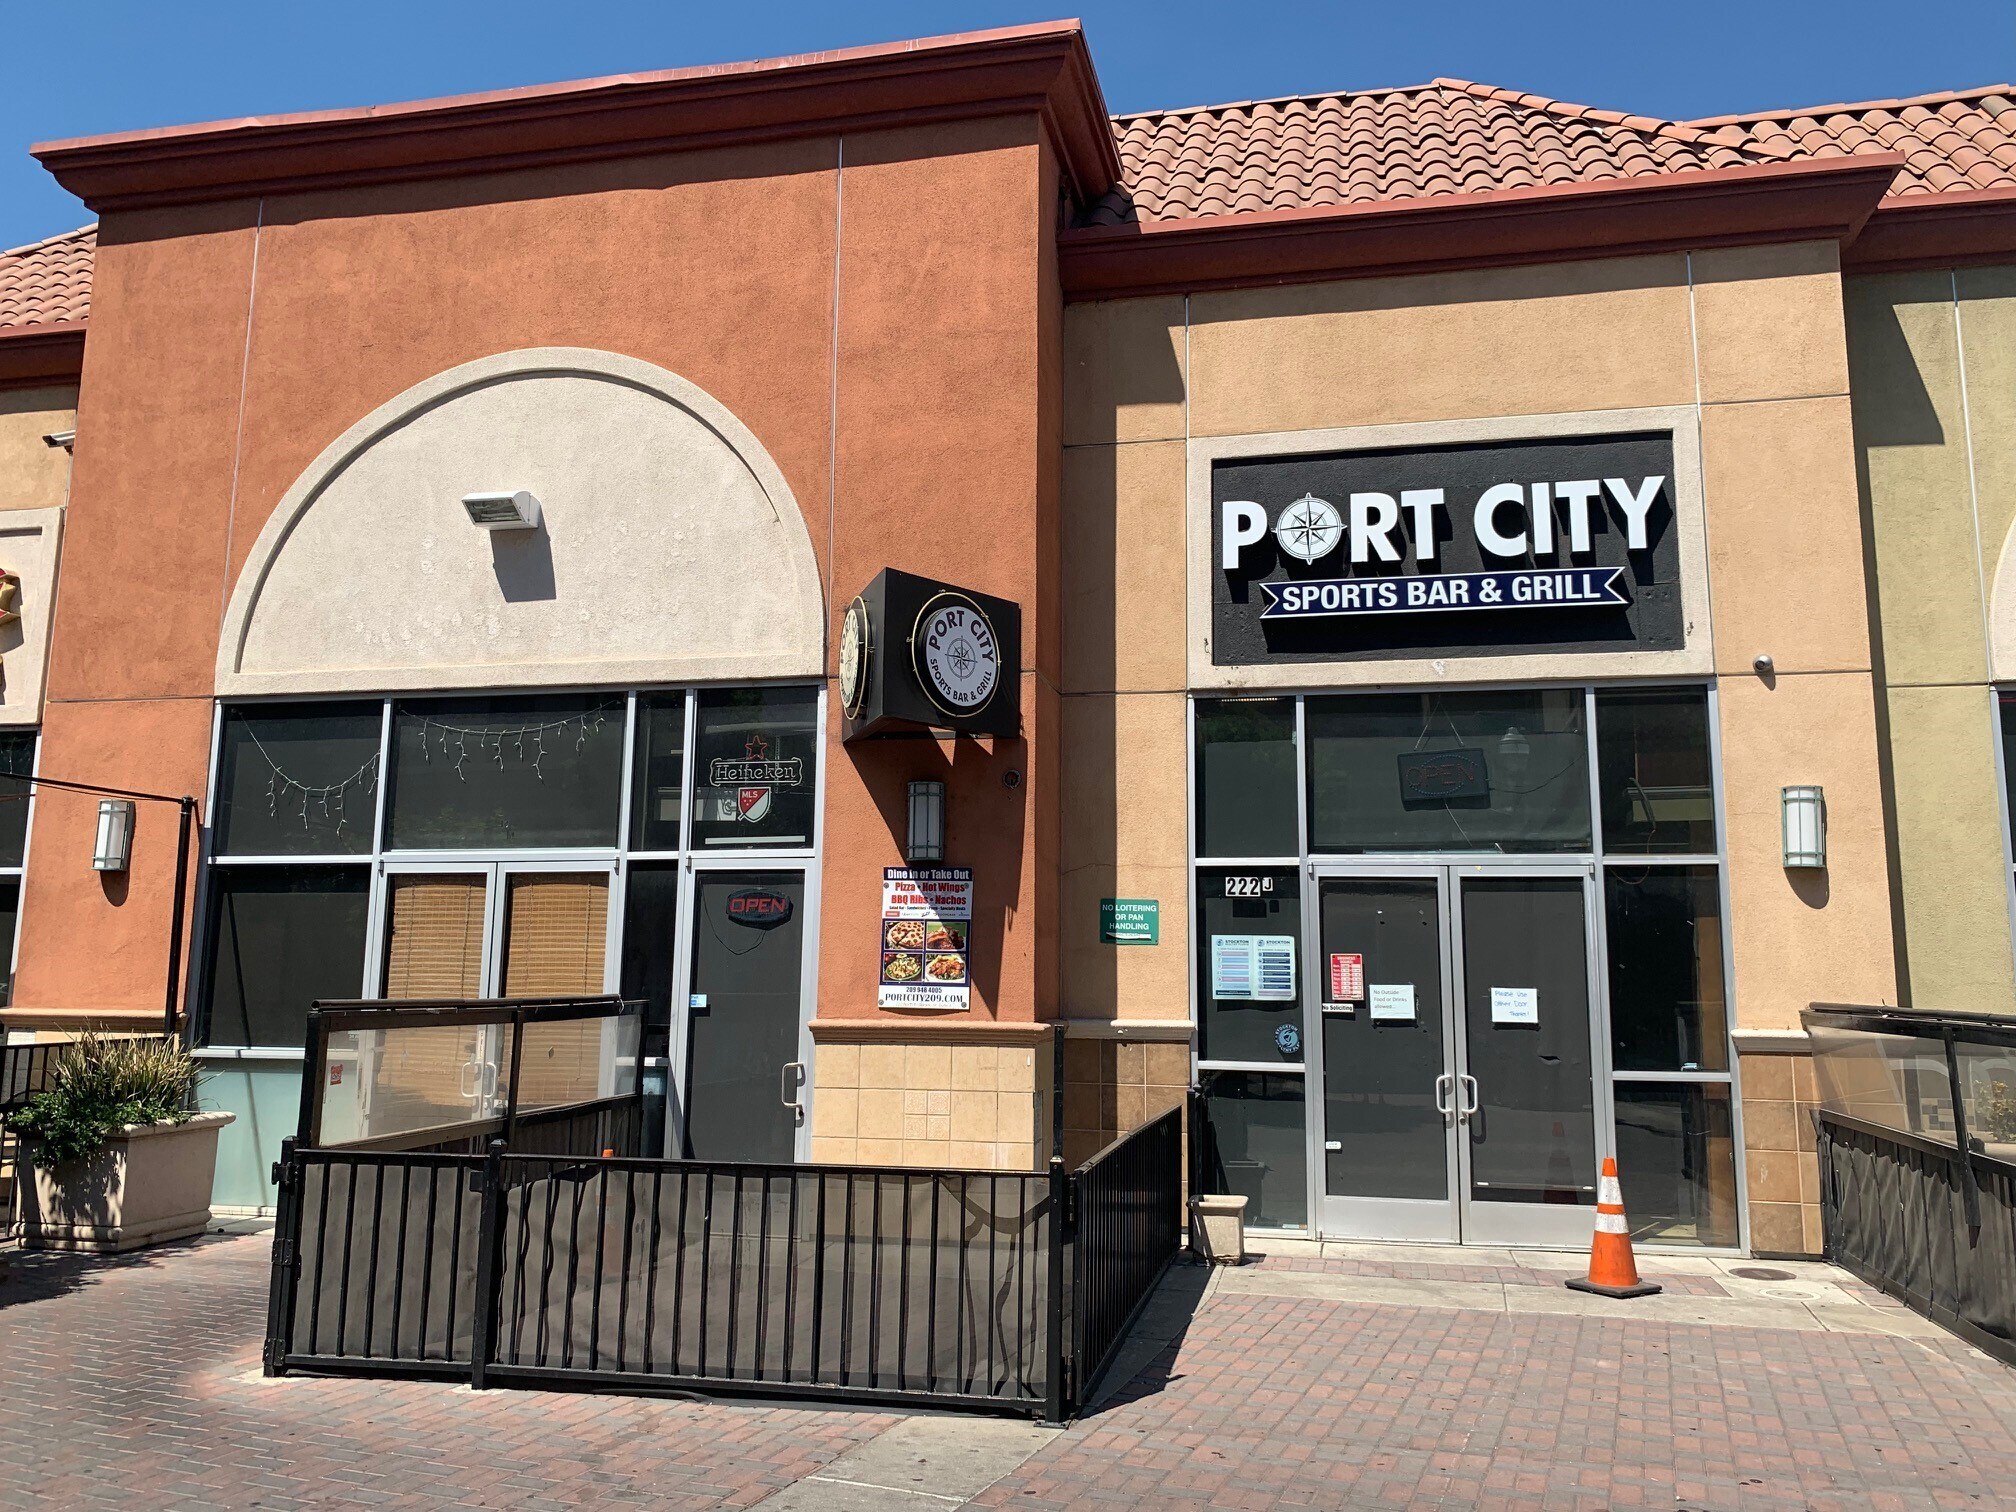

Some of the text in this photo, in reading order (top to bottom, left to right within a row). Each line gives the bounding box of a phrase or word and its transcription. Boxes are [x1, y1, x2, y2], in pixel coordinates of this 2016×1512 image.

[1473, 475, 1665, 557] CITY
[1282, 573, 1601, 612] SPORTS BAR & GRILL
[928, 609, 995, 663] PORT CITY
[930, 658, 992, 703] SPORTS BAR & GRILL
[716, 763, 796, 780] Heineken
[741, 790, 758, 799] MLS
[887, 869, 908, 879] Dine
[920, 870, 929, 879] or
[931, 869, 952, 879] Take
[953, 869, 969, 880] Out
[895, 882, 965, 893] Pizza Hot Wings
[1226, 877, 1272, 896] 222 J
[891, 894, 966, 905] BBQ Ribs Nachos
[729, 898, 787, 913] OPEN
[1115, 904, 1157, 912] LOITERING
[1115, 913, 1144, 921] OR PAN
[1109, 922, 1150, 930] HANDLING
[885, 993, 963, 1003] PORTCITY209.COM
[1329, 1004, 1353, 1012] Soliciting
